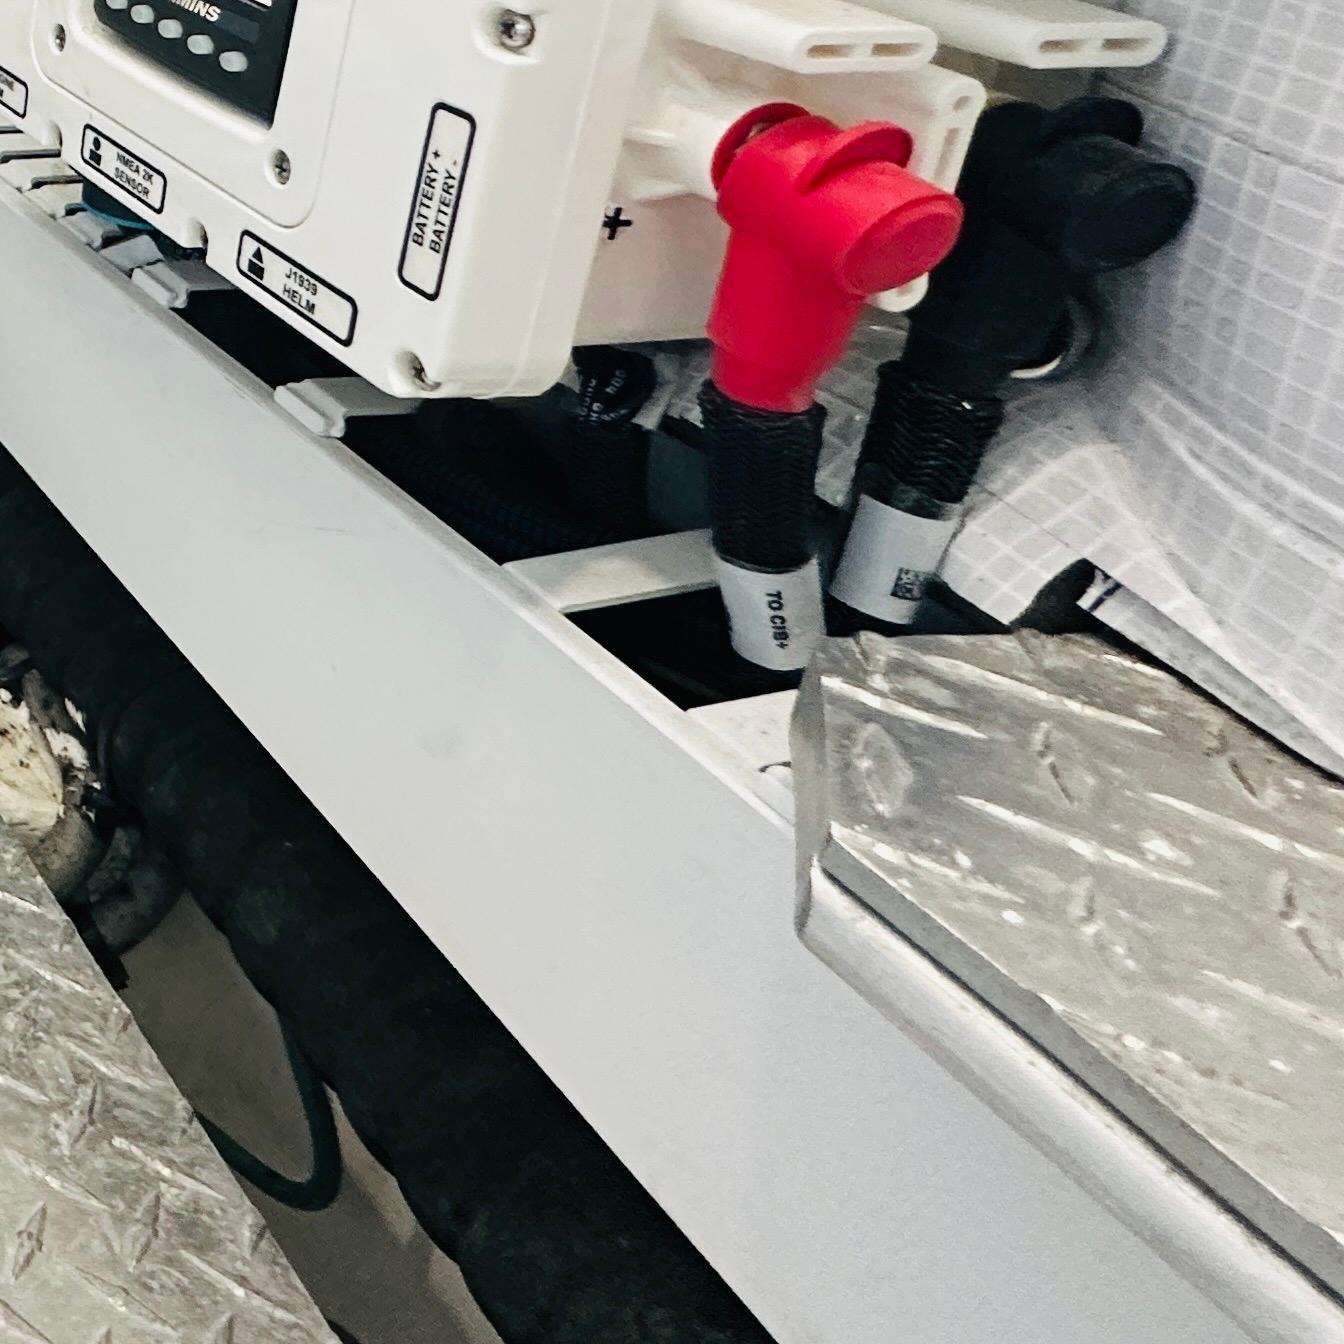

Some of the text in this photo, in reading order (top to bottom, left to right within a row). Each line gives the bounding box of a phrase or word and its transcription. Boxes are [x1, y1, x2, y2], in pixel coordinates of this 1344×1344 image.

[114, 167, 150, 198] SENSOR
[116, 151, 155, 186] NMEA 2K
[411, 163, 440, 247] BATTERY
[429, 169, 457, 254] BATTERY
[285, 267, 318, 296] J1939
[283, 283, 316, 315] HELM
[765, 590, 784, 611] TO
